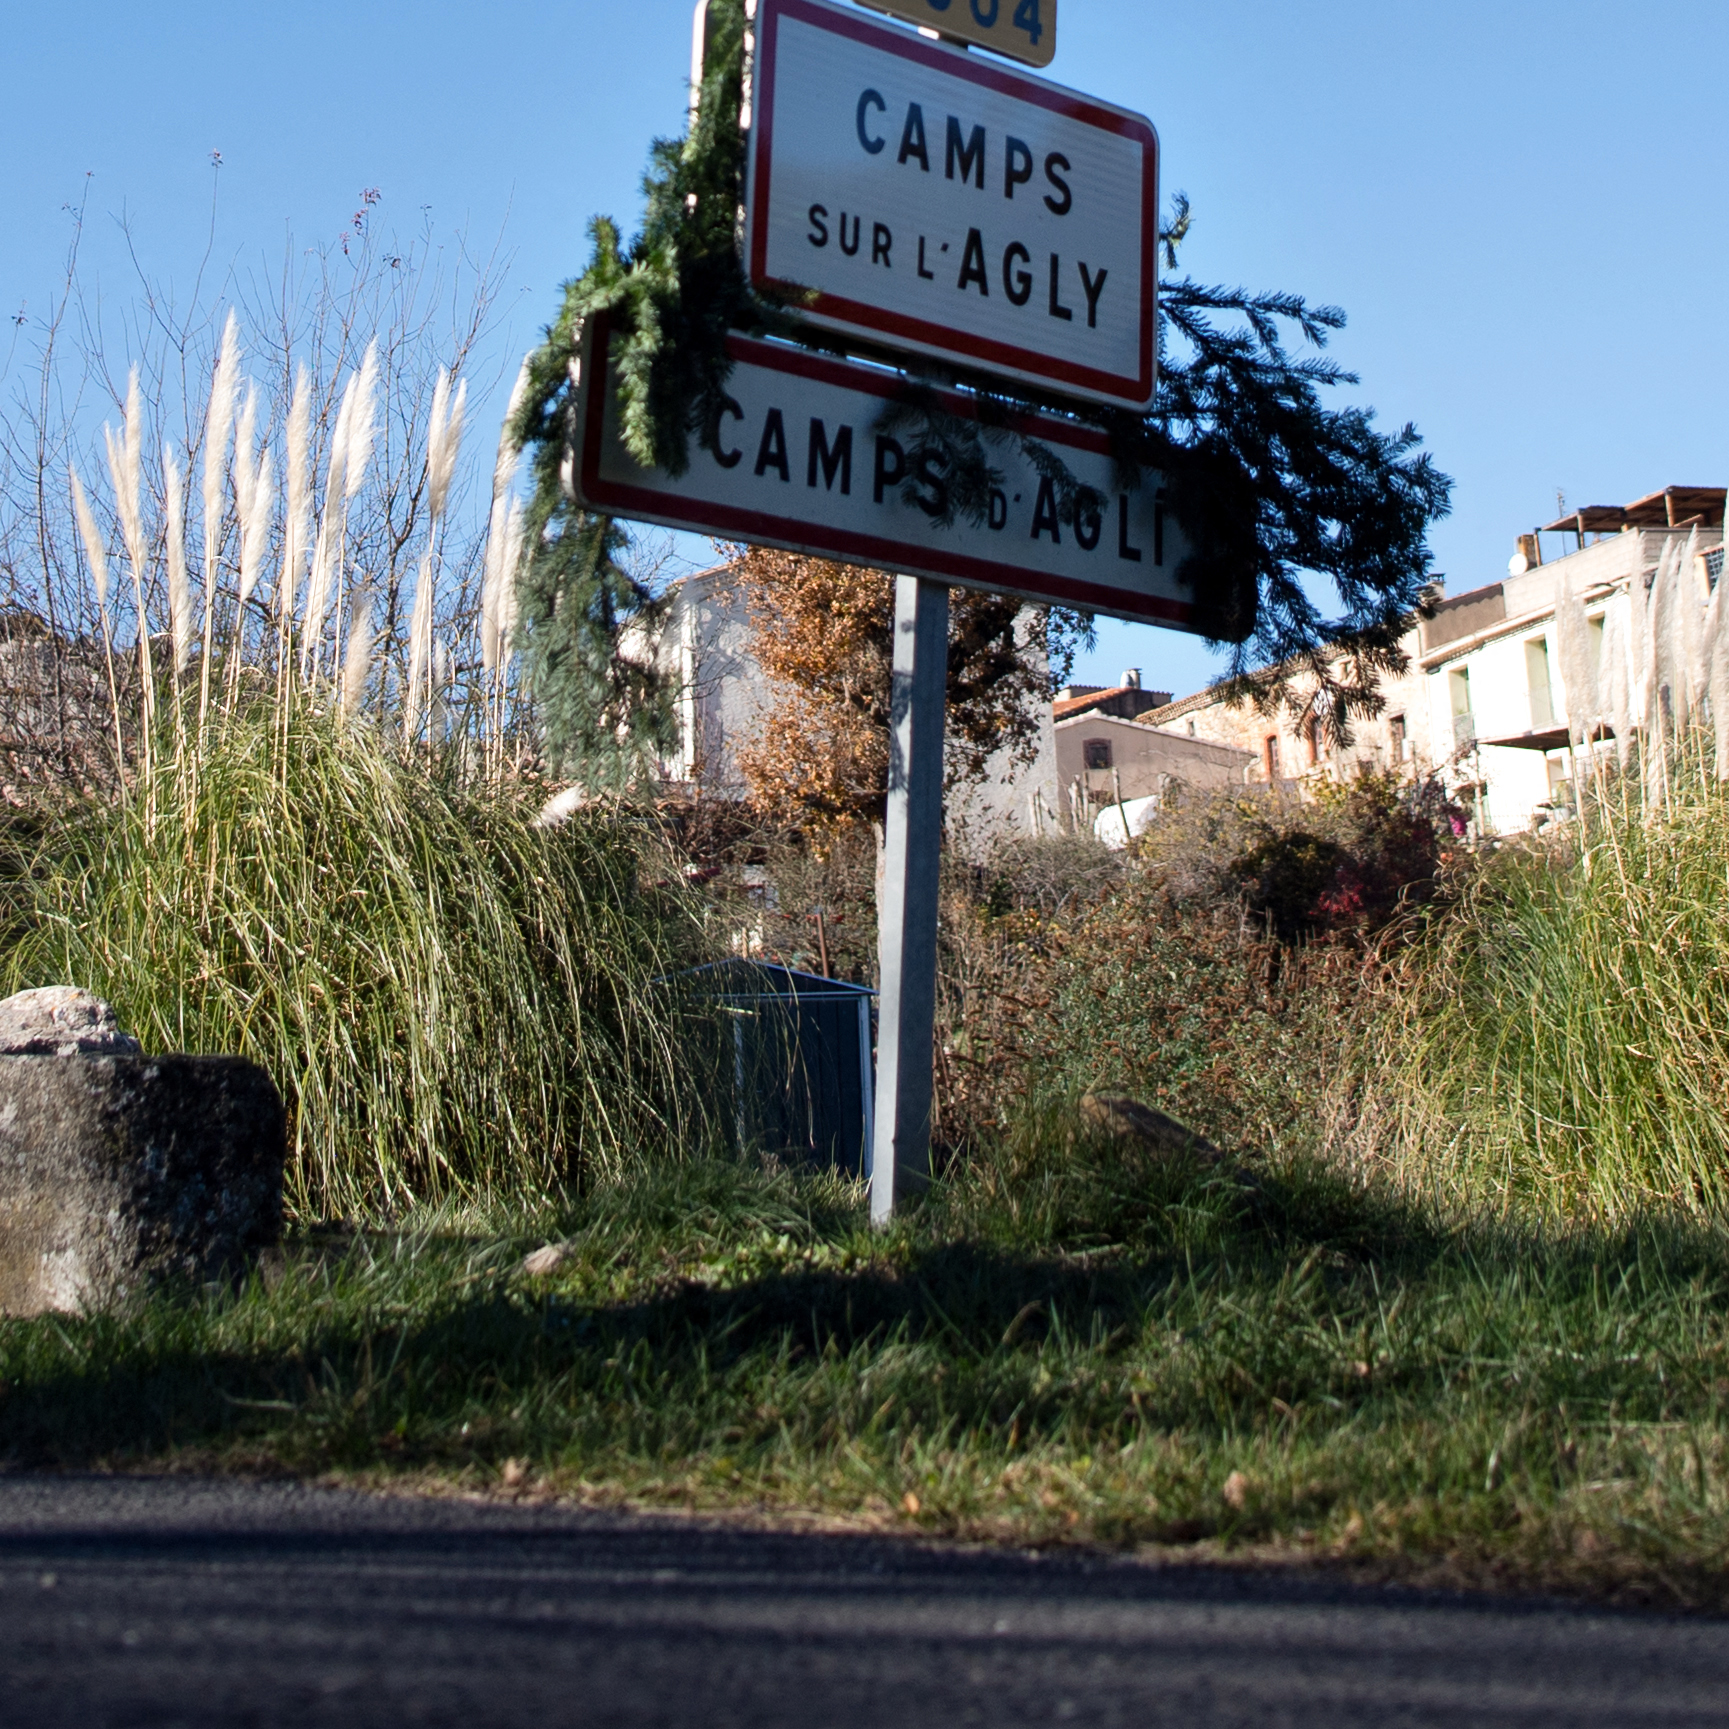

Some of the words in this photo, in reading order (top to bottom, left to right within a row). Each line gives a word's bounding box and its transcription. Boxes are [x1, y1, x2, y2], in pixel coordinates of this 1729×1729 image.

[856, 88, 1073, 216] CAMPS
[807, 203, 893, 269] SUR
[917, 226, 1109, 330] L'AGLY
[710, 395, 949, 518] CAMPS
